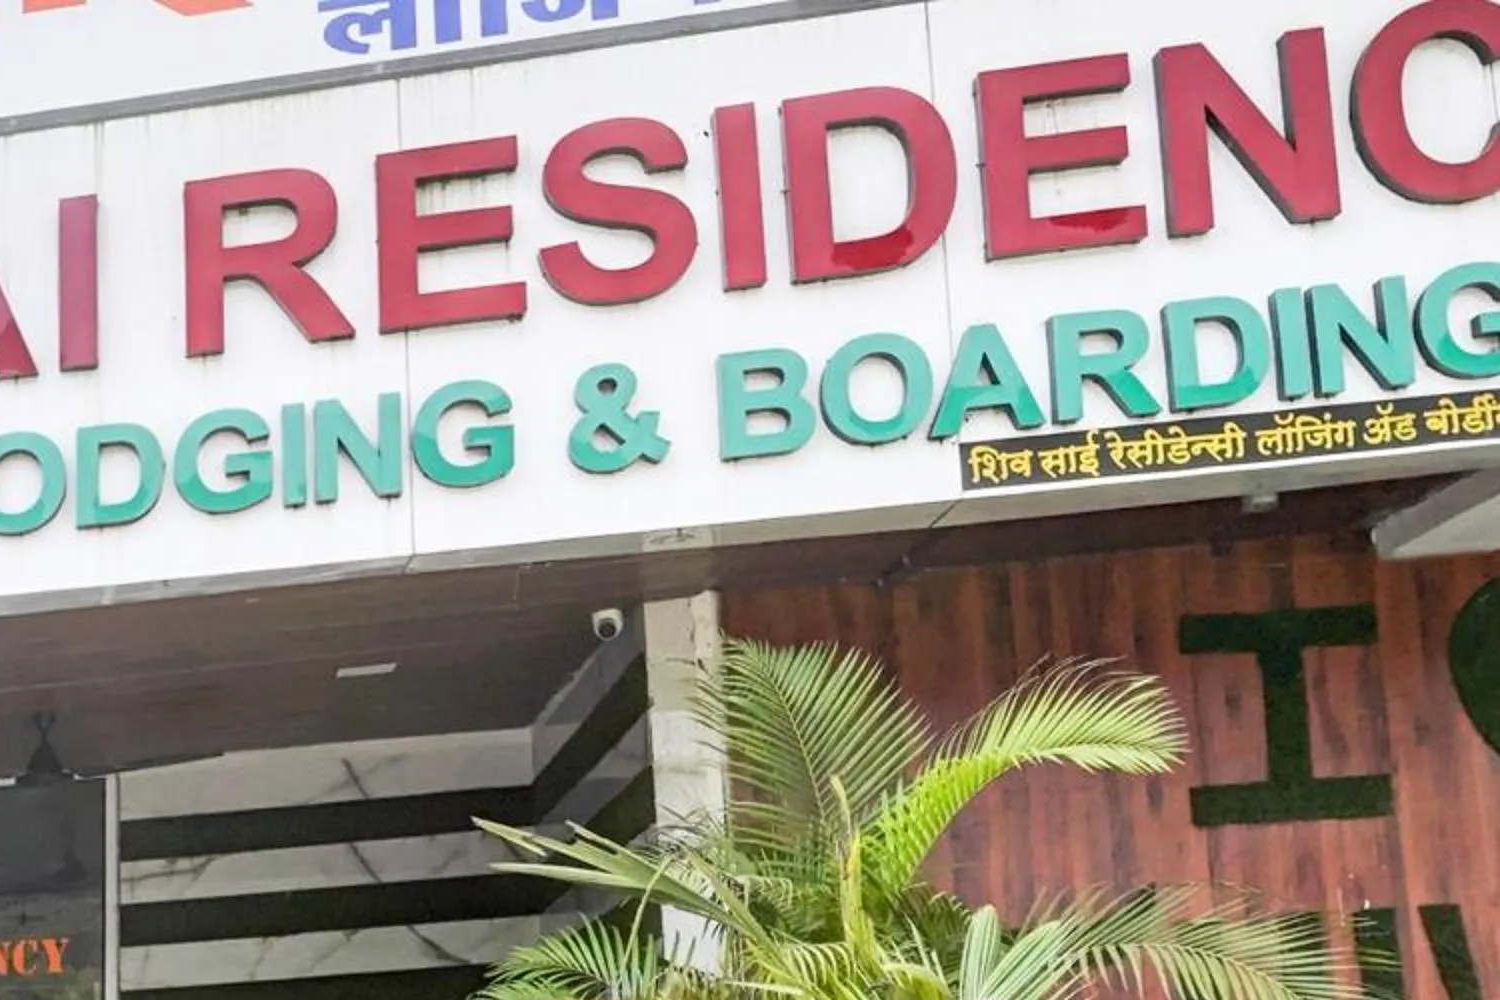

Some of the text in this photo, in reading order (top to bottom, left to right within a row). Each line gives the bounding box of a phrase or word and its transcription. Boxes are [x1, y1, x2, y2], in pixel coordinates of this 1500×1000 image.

[183, 0, 1500, 357] RESIDENC
[568, 363, 670, 475] &
[718, 262, 1500, 463] BOARDING
[968, 446, 1034, 484] शिव
[1038, 430, 1100, 478] साई
[1104, 421, 1247, 469] रेसीडेन्सी
[1255, 412, 1357, 456] लॉजिंग
